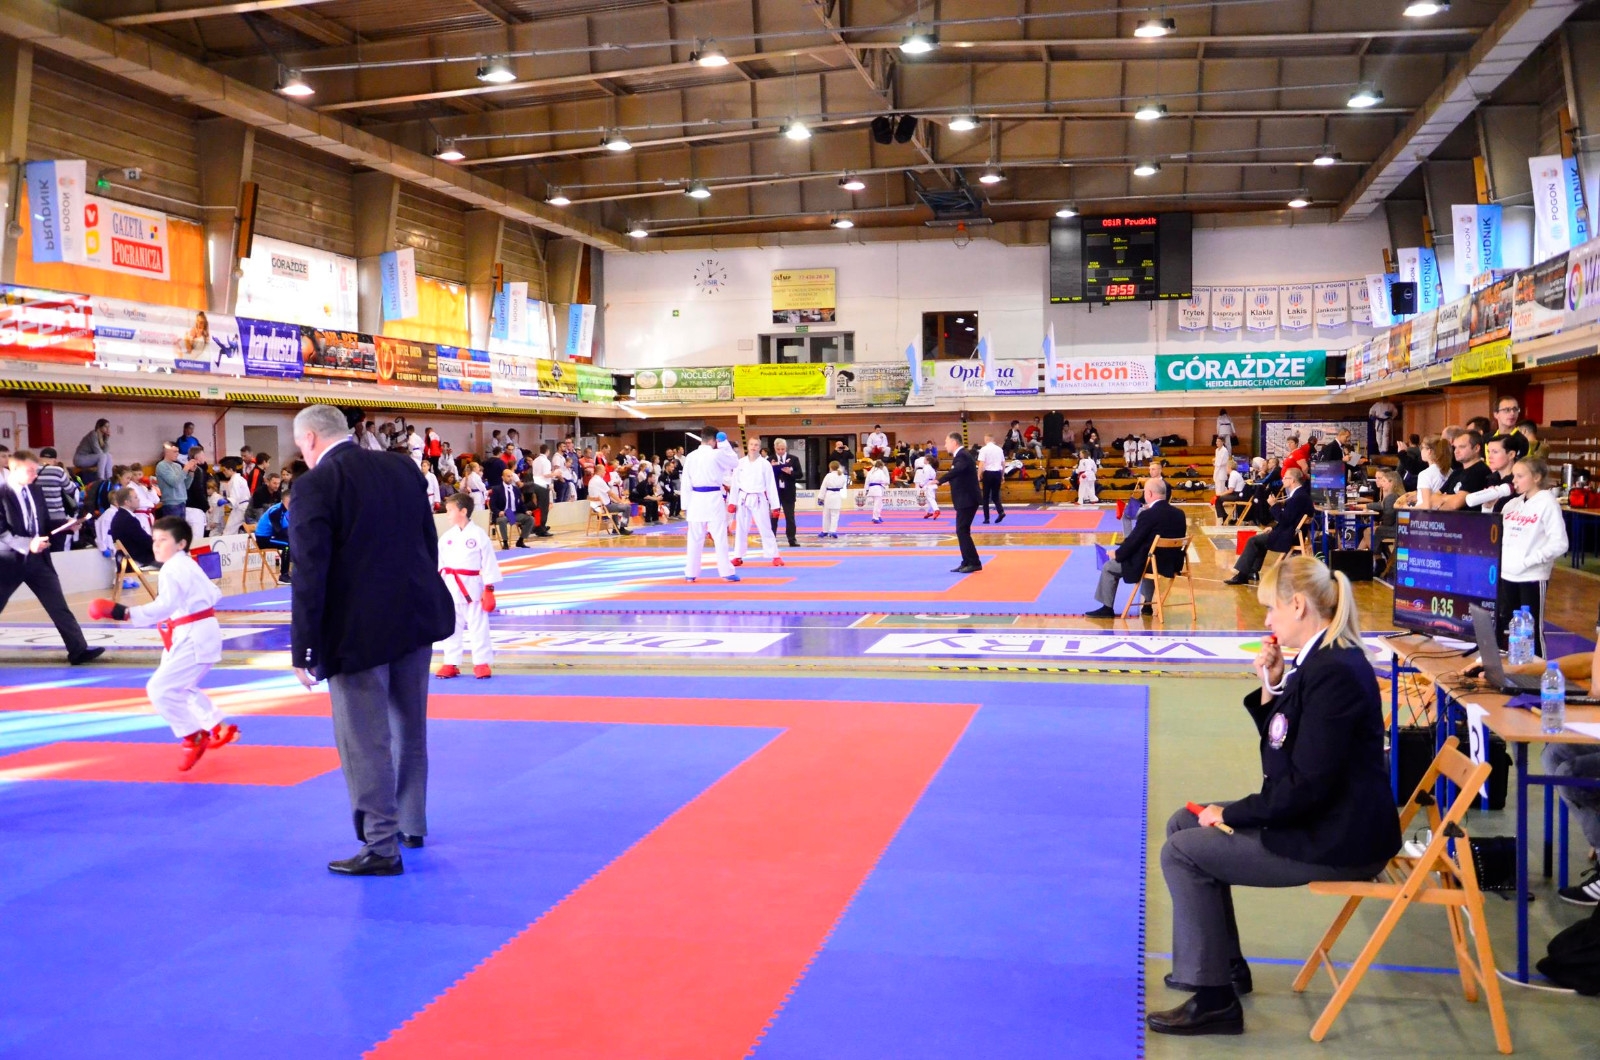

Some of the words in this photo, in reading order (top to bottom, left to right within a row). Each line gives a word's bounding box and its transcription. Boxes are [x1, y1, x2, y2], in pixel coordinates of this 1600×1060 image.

[112, 213, 144, 240] GAZETA
[1125, 217, 1157, 226] Prudnik
[113, 240, 162, 270] POGRANICZA
[1423, 257, 1432, 304] PRUDNIK
[1106, 284, 1135, 295] 13:59
[1182, 309, 1205, 317] Trytek
[1316, 306, 1347, 314] Jankowski
[1167, 353, 1306, 381] GÓRAŻDŻE
[681, 371, 715, 380] NOCLEGI
[1108, 380, 1149, 388] TRANSPORTE
[1205, 379, 1284, 388] HEIDELBERGCEMENT
[1284, 378, 1306, 387] Group
[1397, 525, 1409, 535] POL
[1490, 524, 1498, 544] 0
[1397, 562, 1408, 571] UKR
[1489, 565, 1497, 585] 0
[1431, 596, 1454, 618] 0:35
